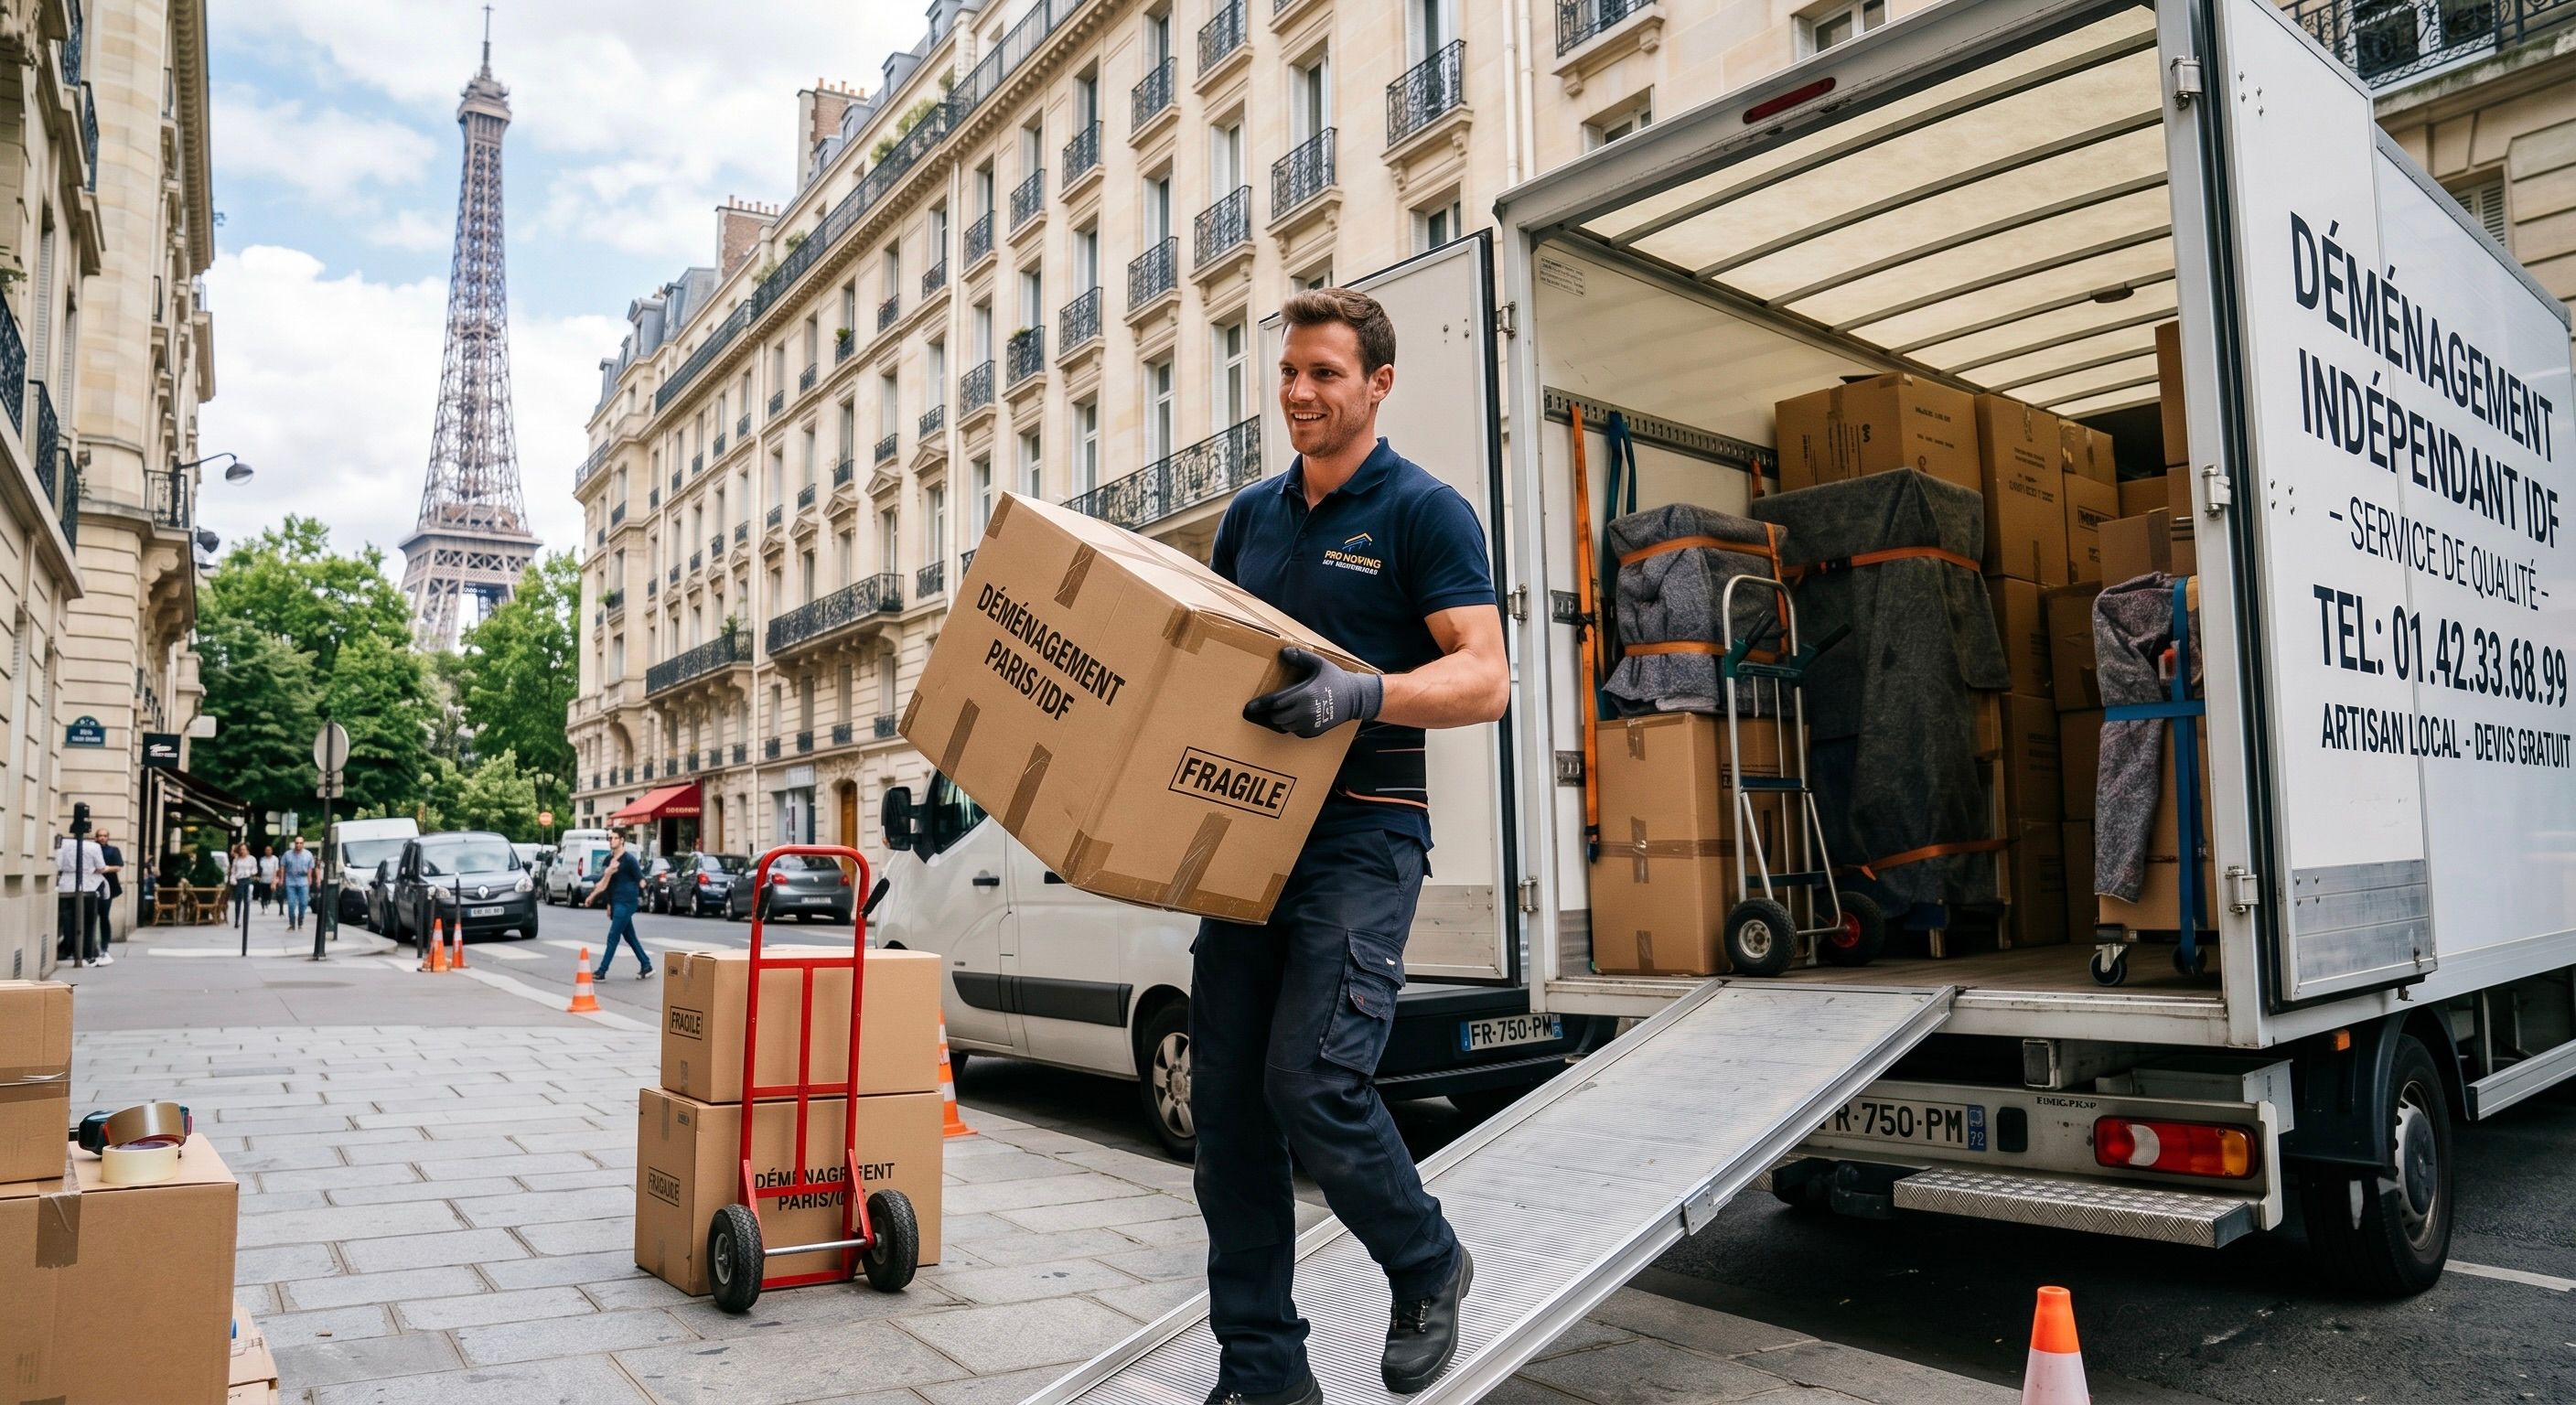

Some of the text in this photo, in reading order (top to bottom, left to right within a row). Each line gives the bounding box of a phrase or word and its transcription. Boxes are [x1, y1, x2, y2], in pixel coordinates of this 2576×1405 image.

[2290, 210, 2553, 463] DÉMÉNAGEMENT
[2299, 348, 2560, 550] INDÉPENDANT IDF
[1324, 550, 1343, 561] PRO
[2349, 496, 2439, 577] SERVICE
[2442, 532, 2468, 587] DE
[2471, 545, 2539, 612] QUALITÉ
[976, 582, 1127, 707] DÉMÉNAGEMENT
[983, 638, 1076, 722] PARIS/IDF
[2313, 584, 2568, 708] TEL: 01.42.33.68.99
[1177, 756, 1287, 810] FRAGILE
[2321, 702, 2405, 755] ARTISAN
[2408, 713, 2462, 759] LOCAL
[2474, 722, 2516, 764] DEVIS
[2518, 728, 2571, 769] GRATUIT
[755, 1163, 896, 1189] DÉMNAGENT
